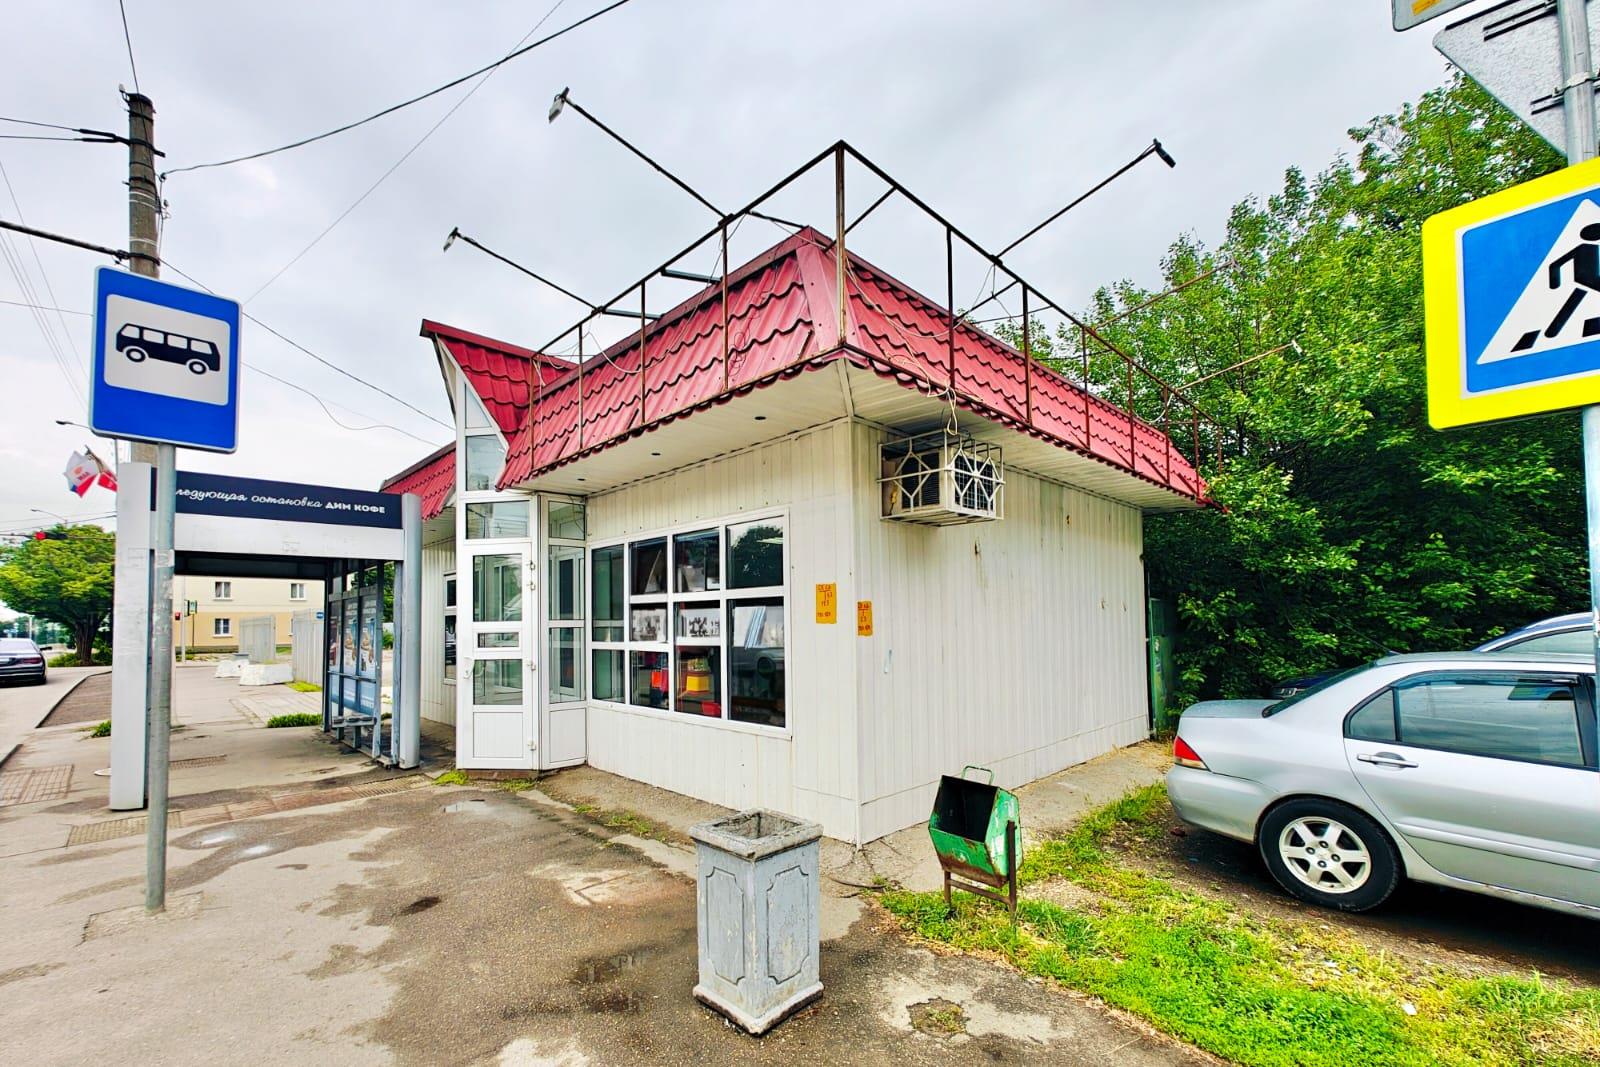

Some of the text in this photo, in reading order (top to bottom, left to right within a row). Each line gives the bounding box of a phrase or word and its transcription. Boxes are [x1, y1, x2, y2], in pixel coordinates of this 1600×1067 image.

[176, 488, 247, 502] ледующая
[251, 494, 323, 508] остановка
[354, 504, 386, 514] КОФЕ
